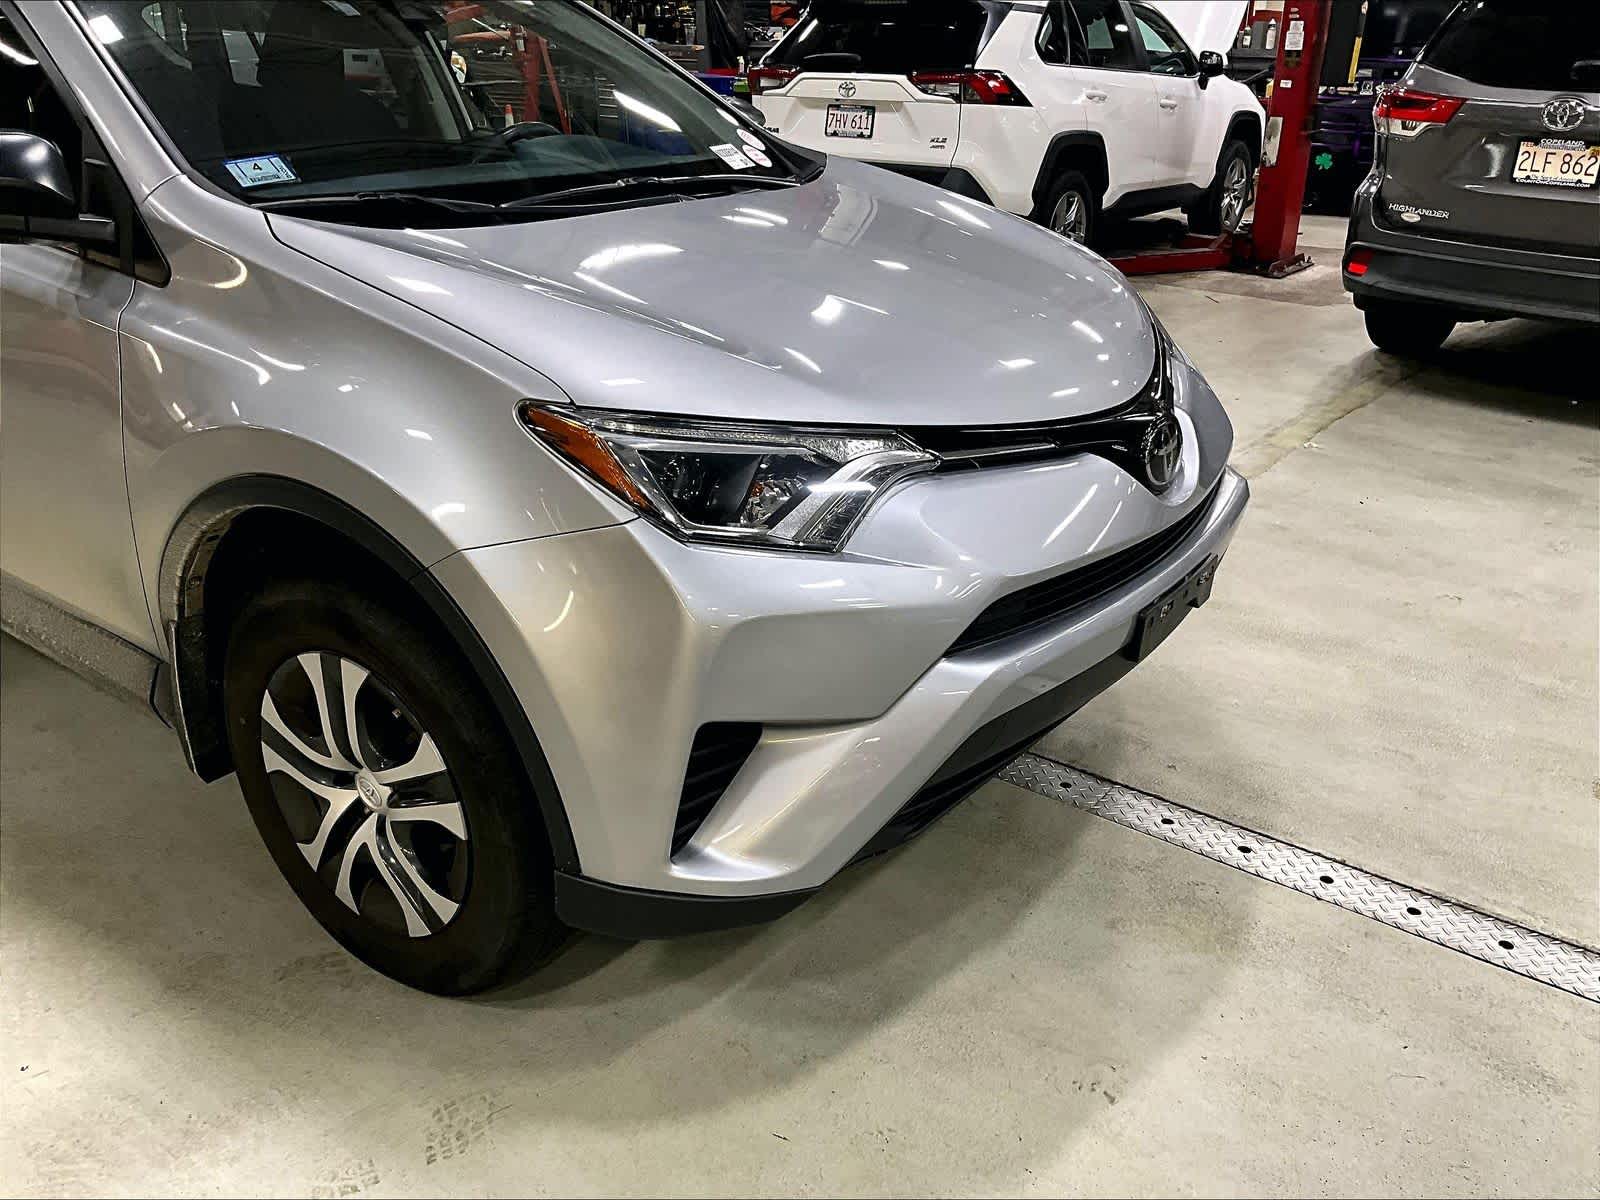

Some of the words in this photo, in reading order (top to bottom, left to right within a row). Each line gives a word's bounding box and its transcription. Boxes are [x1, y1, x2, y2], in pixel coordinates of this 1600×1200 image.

[828, 112, 849, 129] 7HV
[850, 113, 870, 130] 611
[1540, 138, 1585, 146] COPELAND
[1518, 151, 1556, 173] 2LF
[1560, 153, 1598, 177] 862
[1516, 178, 1590, 188] COUNTONCOPELAND.COM
[1388, 203, 1449, 219] HIGHLANDER
